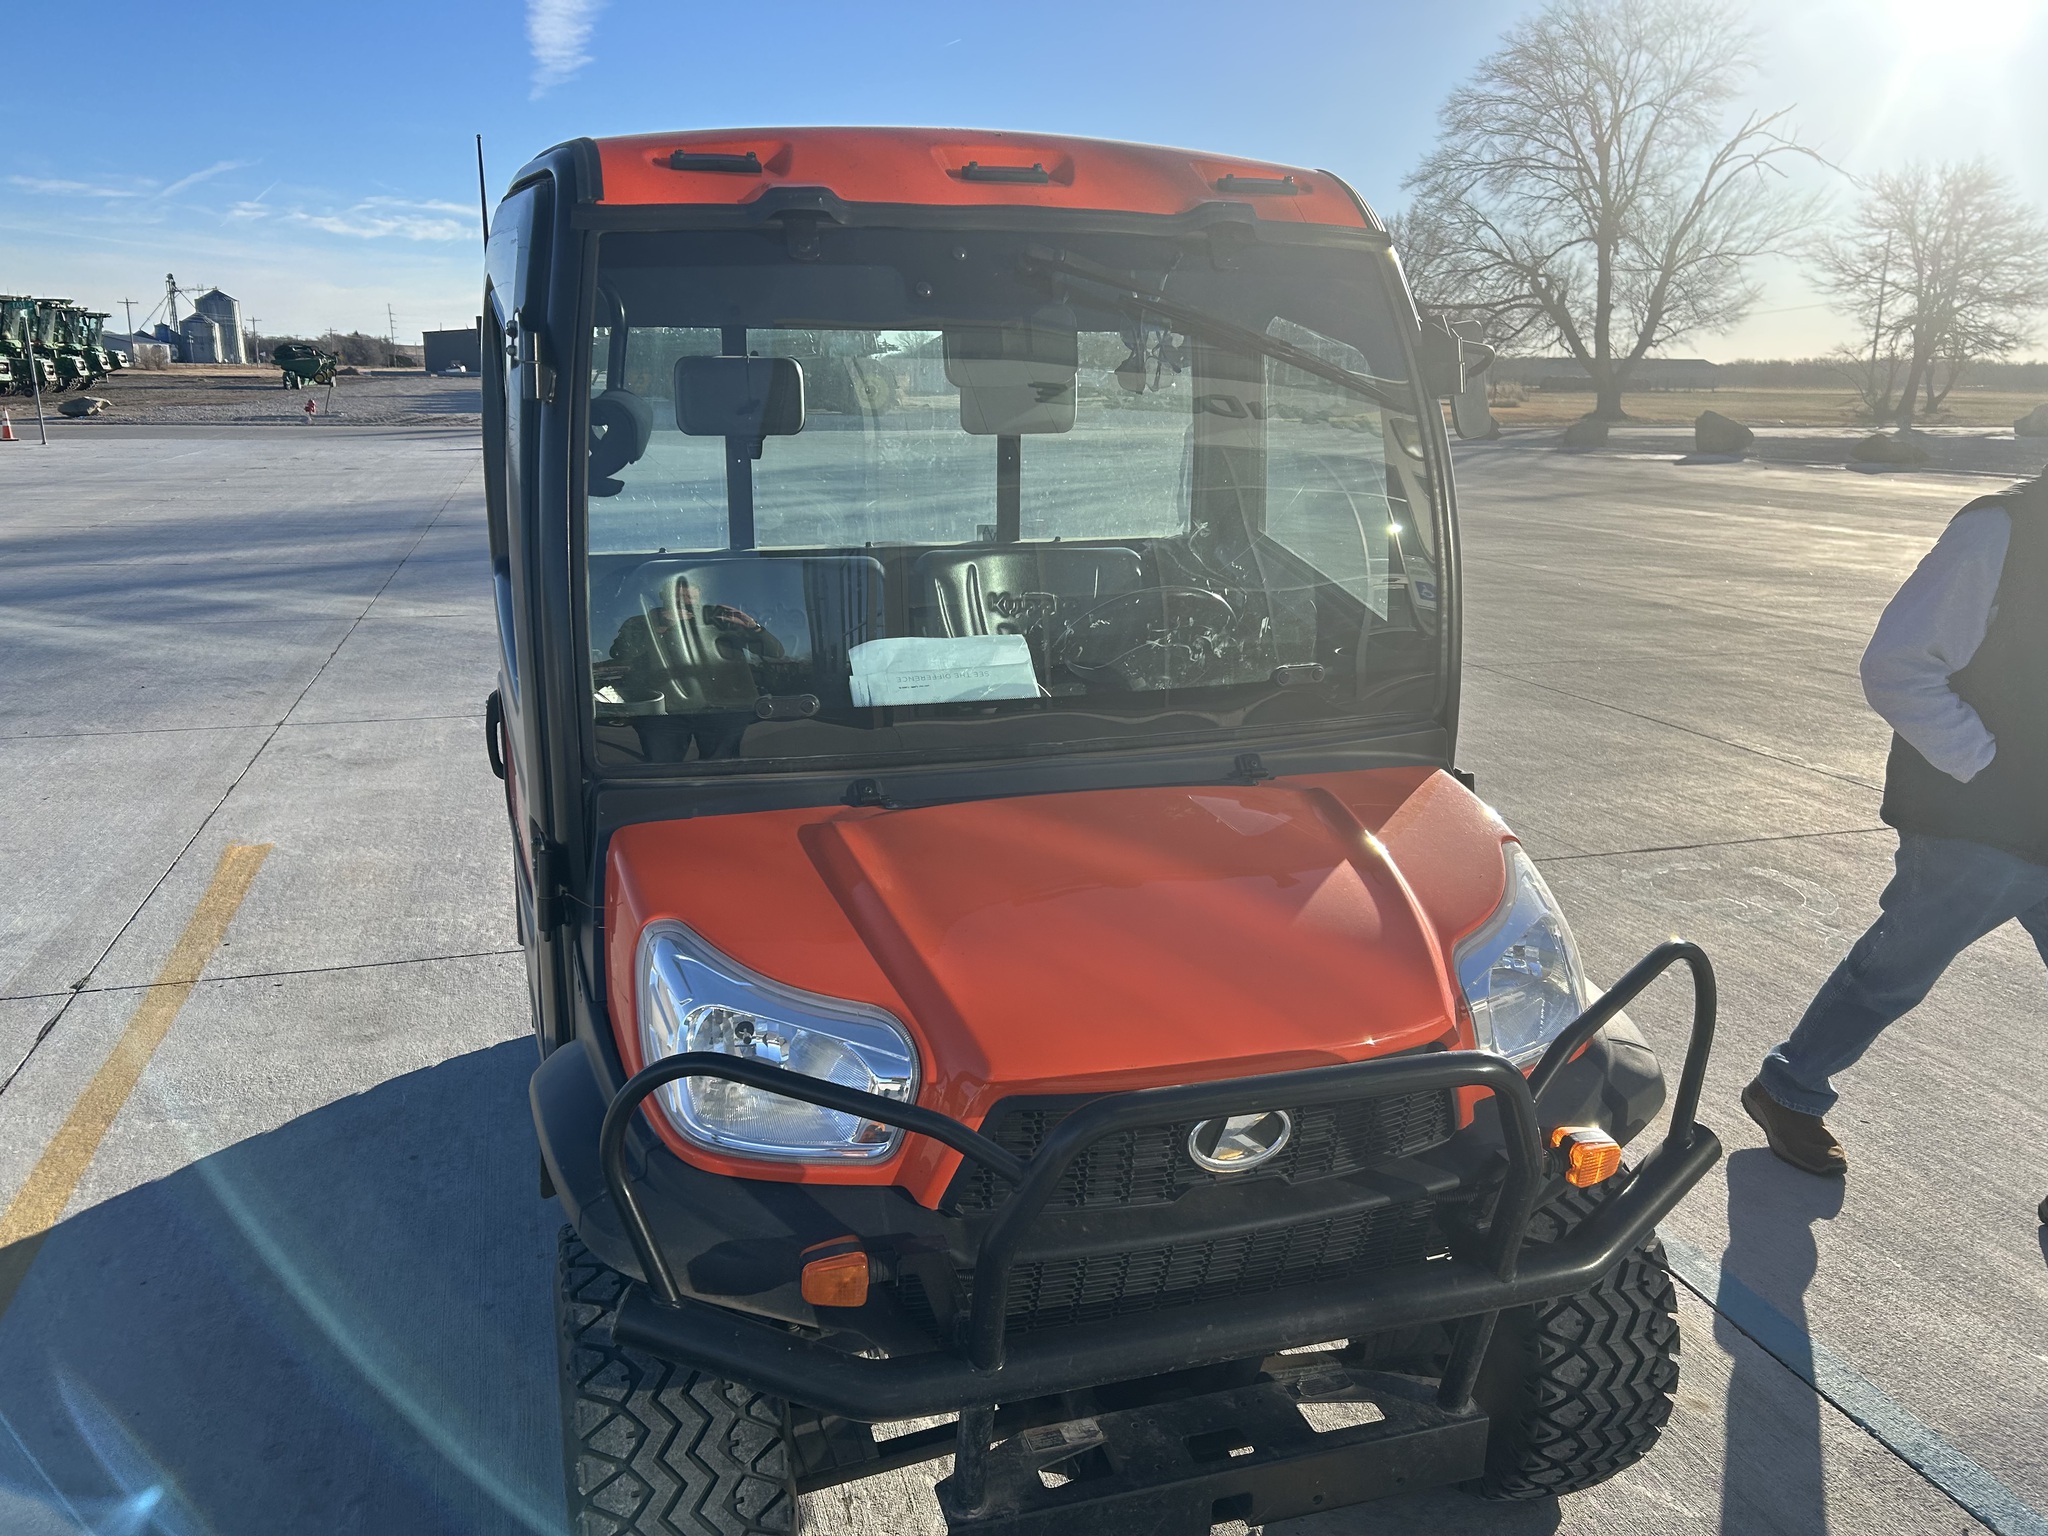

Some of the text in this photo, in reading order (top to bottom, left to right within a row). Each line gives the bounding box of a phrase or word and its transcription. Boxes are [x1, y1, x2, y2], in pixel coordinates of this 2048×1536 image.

[896, 670, 990, 683] SEE THE DIFFERENCE
